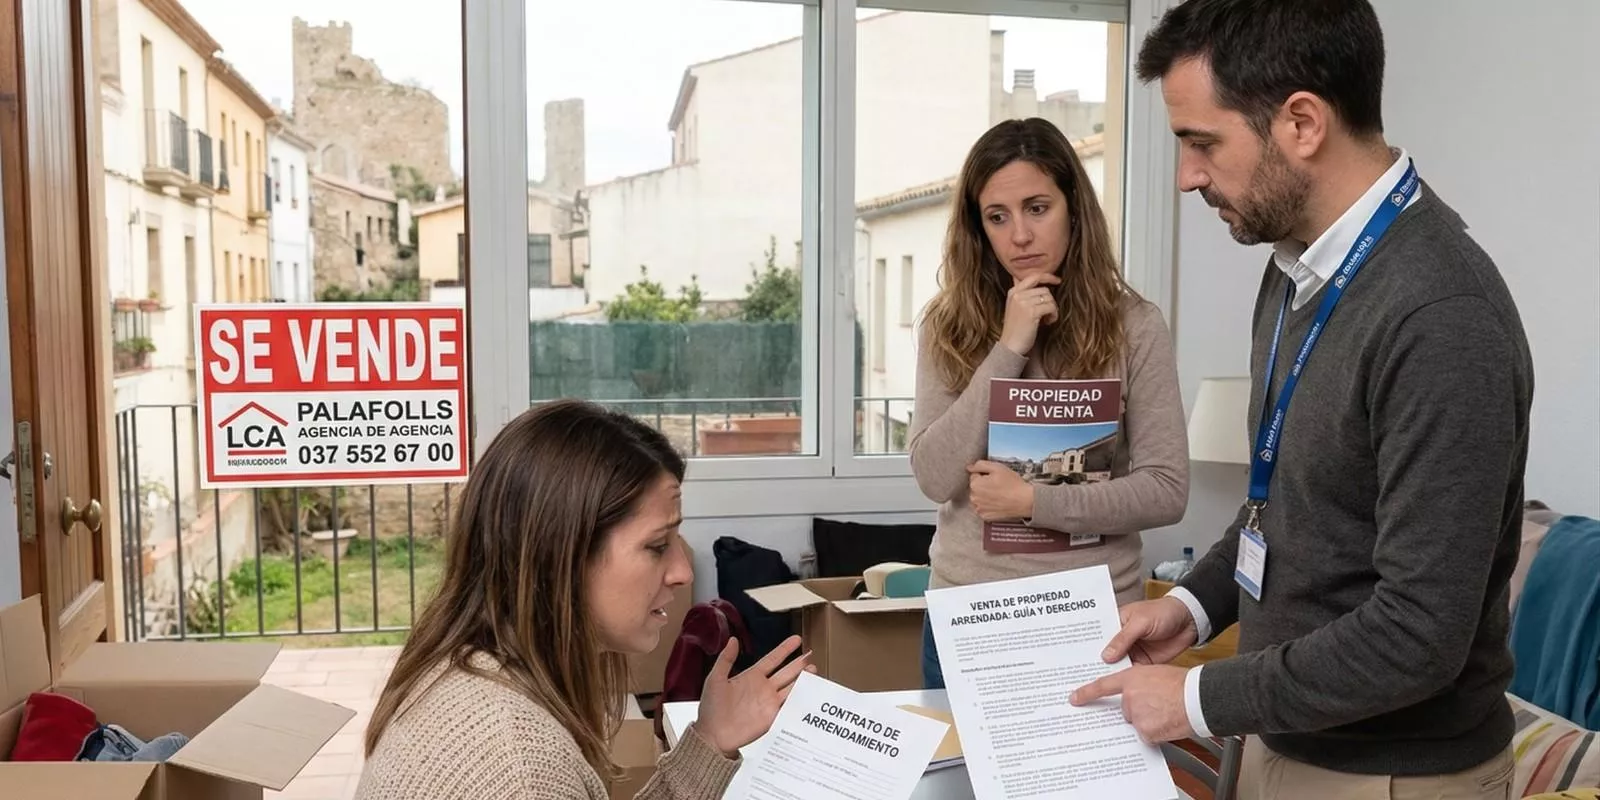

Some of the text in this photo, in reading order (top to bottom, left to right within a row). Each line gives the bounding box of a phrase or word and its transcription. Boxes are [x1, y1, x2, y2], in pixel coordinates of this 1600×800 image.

[210, 318, 458, 384] SE VENDE
[1009, 388, 1102, 402] PROPIEDAD
[297, 400, 453, 421] PALAFOLLS
[1015, 405, 1094, 418] EN VENTA
[227, 425, 286, 447] LCA
[298, 424, 453, 438] AGENCIA DE AGENCIA
[346, 444, 386, 463] 552
[393, 443, 420, 462] 67
[427, 443, 454, 461] 00
[970, 590, 1070, 611] VENTA DE PROPIEDAD
[951, 599, 1096, 626] ARRENDADA: GUÍA Y DERECHOS
[820, 702, 901, 741] CONTRATO DE
[802, 713, 900, 758] ARRENDAMIENTO
